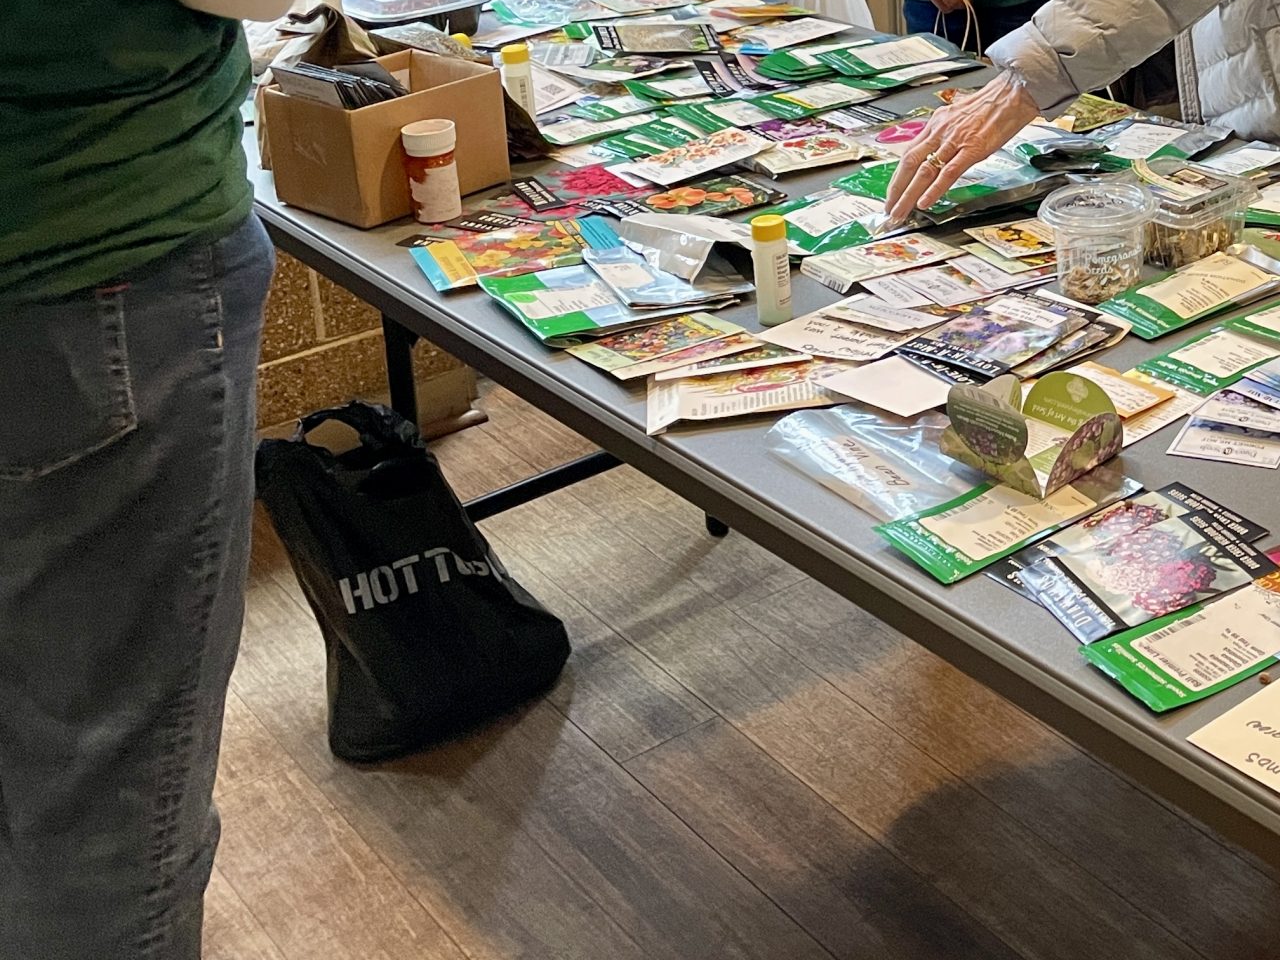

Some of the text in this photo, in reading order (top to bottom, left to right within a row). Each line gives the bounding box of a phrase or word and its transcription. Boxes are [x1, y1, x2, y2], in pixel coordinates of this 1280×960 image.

[1031, 404, 1046, 416] Seed
[1045, 407, 1055, 418] of
[1054, 412, 1066, 422] Art
[1066, 416, 1076, 424] the
[339, 554, 421, 614] HOT
[1143, 644, 1202, 688] Ball Premier Line
